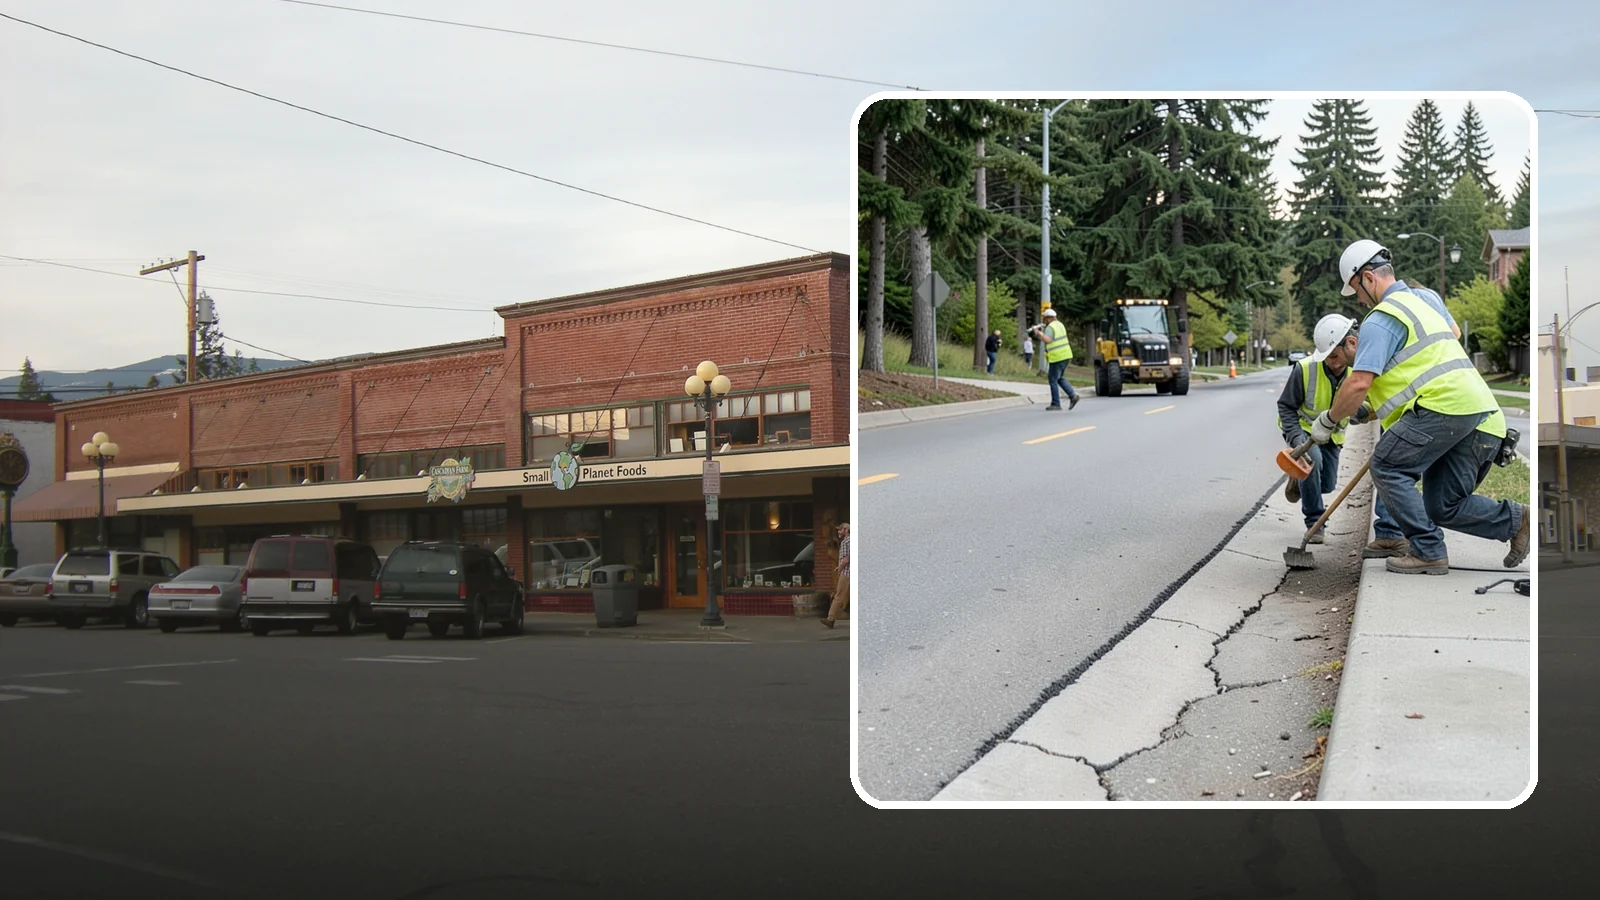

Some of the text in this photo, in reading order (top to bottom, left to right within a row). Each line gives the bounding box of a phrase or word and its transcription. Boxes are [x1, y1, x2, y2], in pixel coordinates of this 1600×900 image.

[456, 465, 469, 474] FARM
[523, 464, 647, 483] Small Planet Foods
